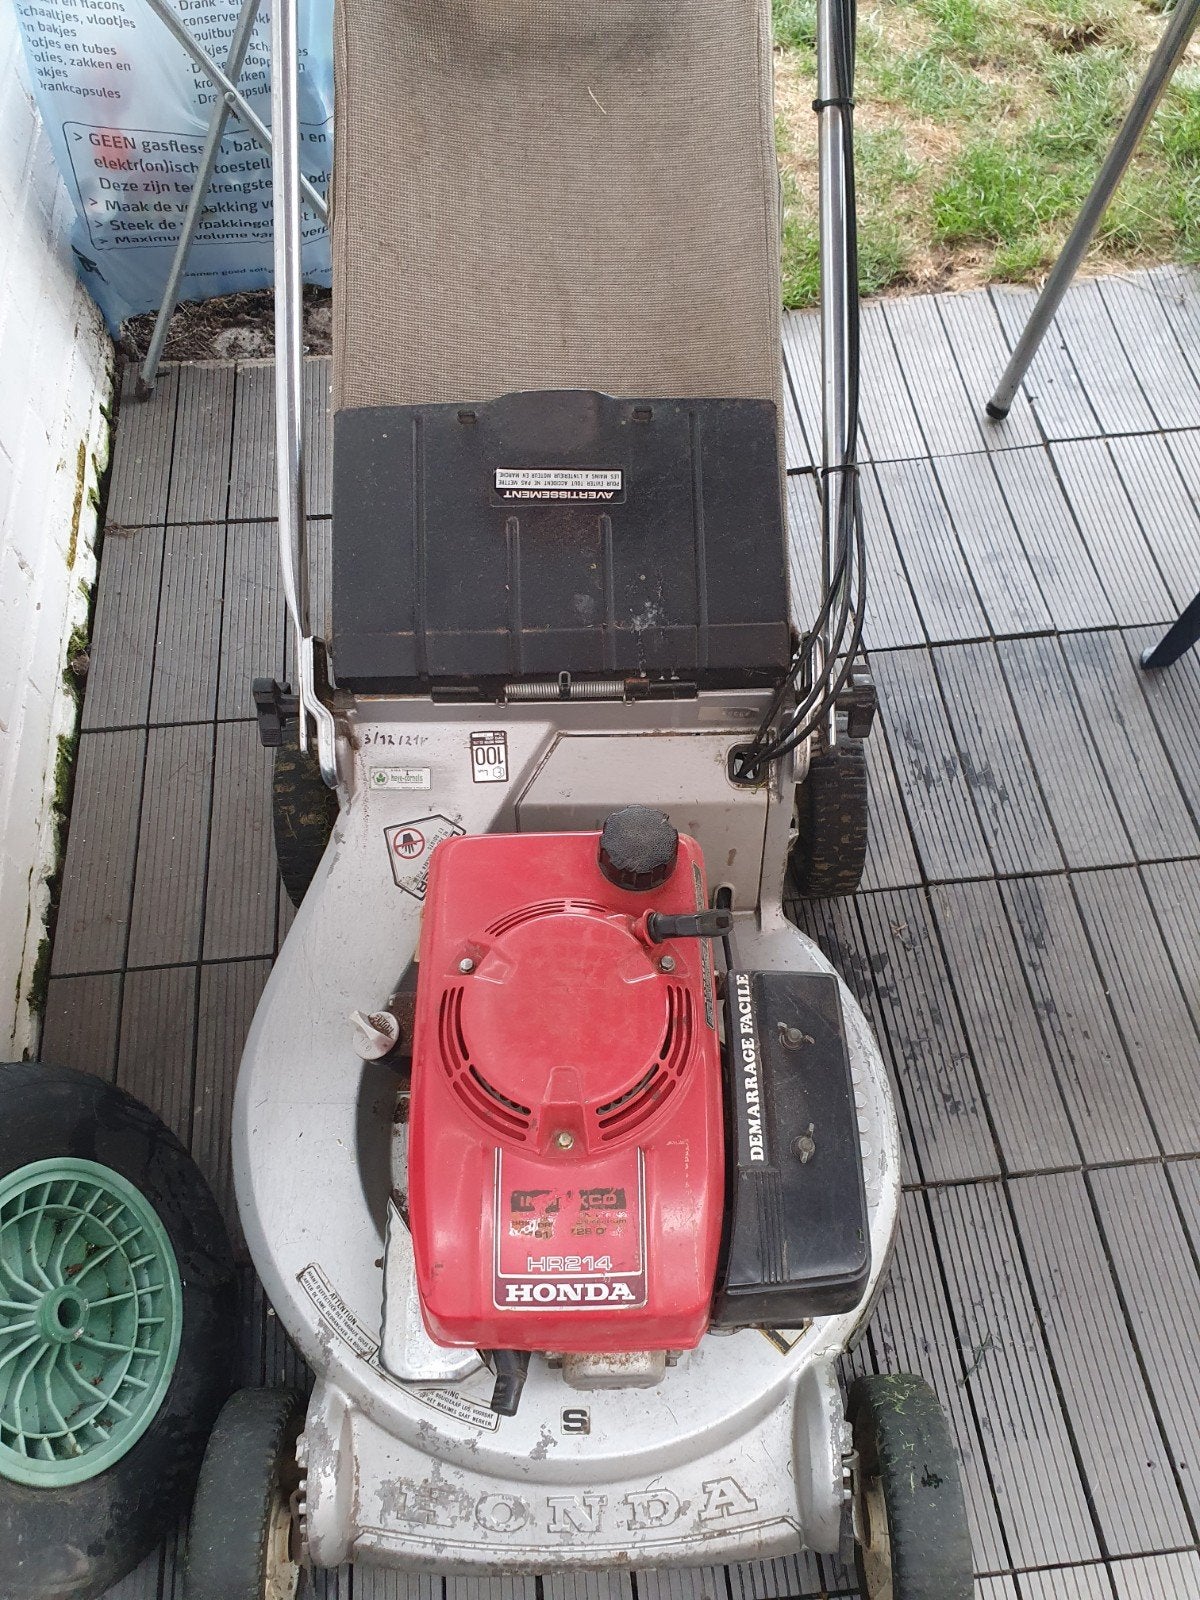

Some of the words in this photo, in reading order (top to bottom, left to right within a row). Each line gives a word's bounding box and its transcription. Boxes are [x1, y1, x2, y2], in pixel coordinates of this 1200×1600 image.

[180, 0, 216, 11] Drank
[37, 21, 77, 37] bakjes
[86, 14, 136, 29] vlootjes
[27, 36, 61, 49] otjes
[64, 42, 79, 52] en
[82, 43, 117, 56] tubes
[31, 50, 67, 66] olies,
[70, 57, 113, 70] zakken
[116, 62, 131, 71] en
[36, 67, 69, 79] akjes
[88, 132, 137, 150] GEEN
[308, 133, 326, 143] en
[93, 156, 200, 174] elektr(on)isch
[214, 157, 272, 174] toestell
[99, 177, 139, 192] Deze
[143, 180, 171, 194] zijn
[105, 199, 149, 213] Maak
[153, 201, 172, 212] de
[110, 219, 154, 231] Steek
[158, 219, 177, 230] de
[194, 232, 247, 240] volume
[503, 490, 613, 499] AVERTISSEMENT
[475, 746, 504, 766] 100
[735, 973, 754, 1036] FACILE
[741, 1036, 764, 1162] DEMARRAGE
[527, 1255, 612, 1272] HR214
[505, 1282, 635, 1302] HONDA
[328, 1291, 358, 1326] ATTENTION
[563, 1409, 588, 1431] S
[394, 1476, 760, 1534] HONDA
